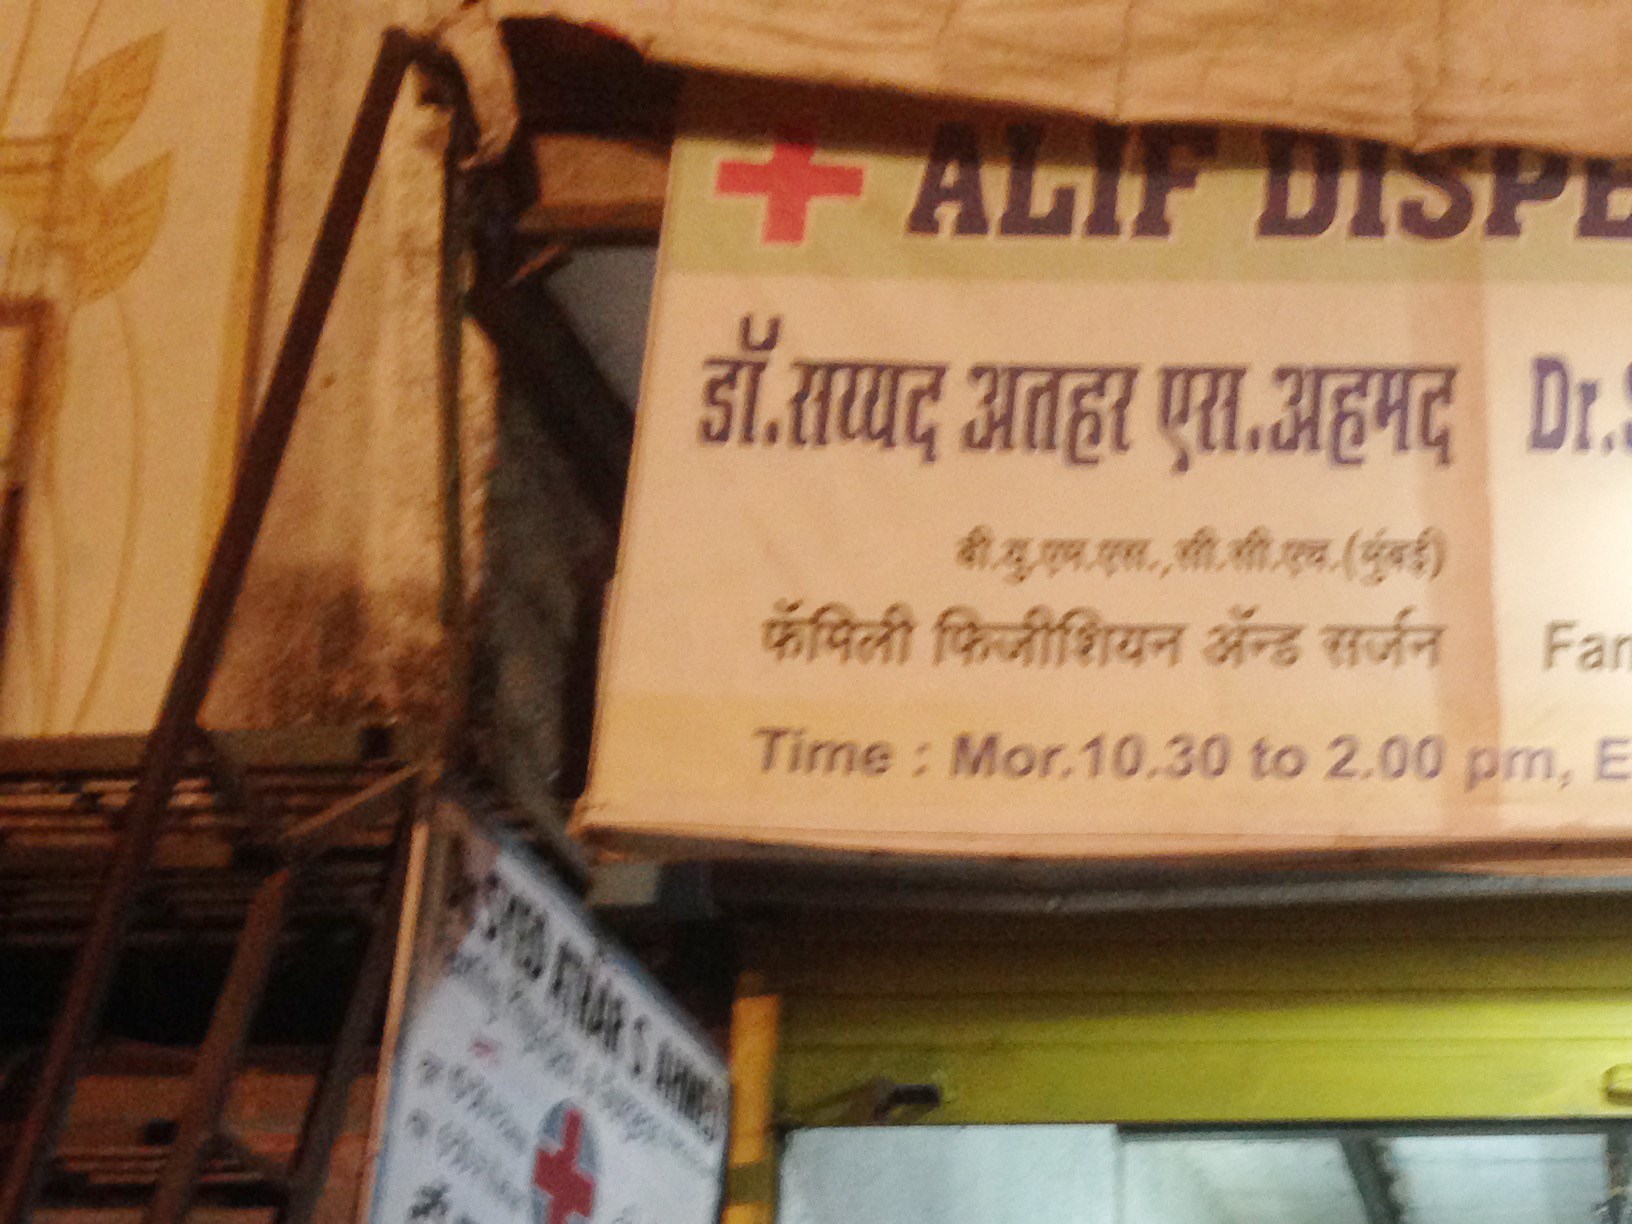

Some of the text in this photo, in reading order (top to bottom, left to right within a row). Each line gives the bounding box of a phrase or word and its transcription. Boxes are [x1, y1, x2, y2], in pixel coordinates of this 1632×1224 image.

[904, 120, 1217, 240] ALIF
[961, 361, 1141, 466] अतहर
[1318, 603, 1449, 669] सर्जन
[755, 725, 893, 779] Time
[947, 731, 1234, 782] Mor.10.30
[1251, 735, 1310, 781] to
[1323, 735, 1445, 783] 2.00
[1464, 742, 1574, 793] pm,
